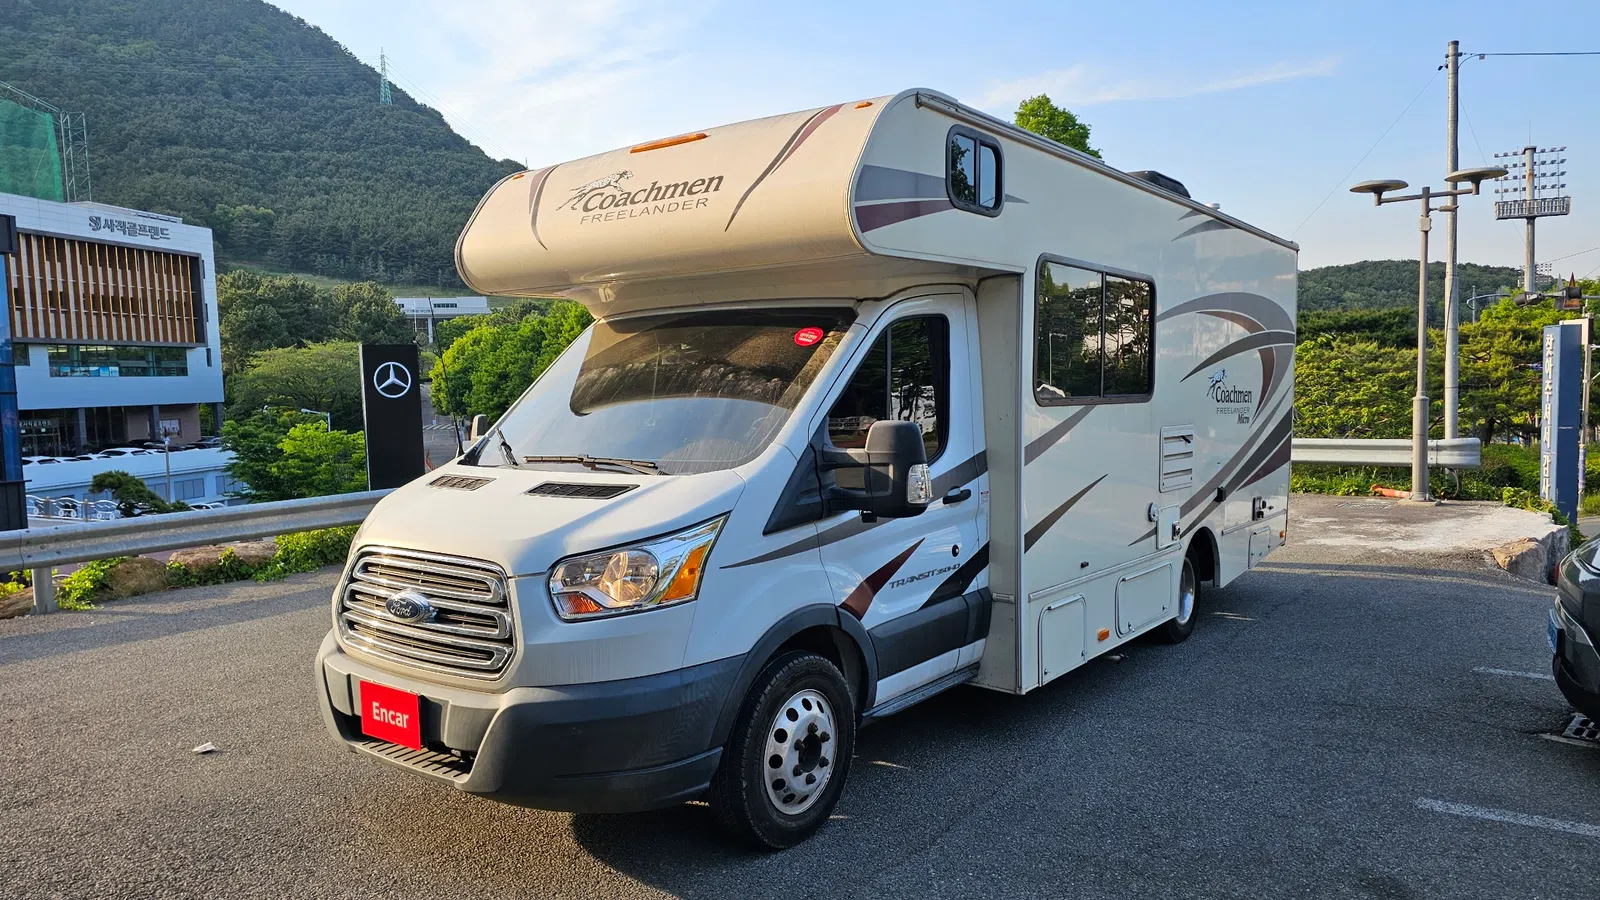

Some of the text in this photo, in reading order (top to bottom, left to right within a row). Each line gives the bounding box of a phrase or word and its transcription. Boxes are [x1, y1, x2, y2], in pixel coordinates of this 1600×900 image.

[582, 175, 724, 212] Coachmen
[580, 197, 709, 225] FREELANDER
[1215, 385, 1252, 403] Coachmen
[1216, 406, 1250, 415] FREELANDER
[1237, 413, 1250, 424] Micro
[889, 568, 937, 589] TRANSIT
[390, 600, 412, 617] Ford
[372, 701, 409, 729] Encar
